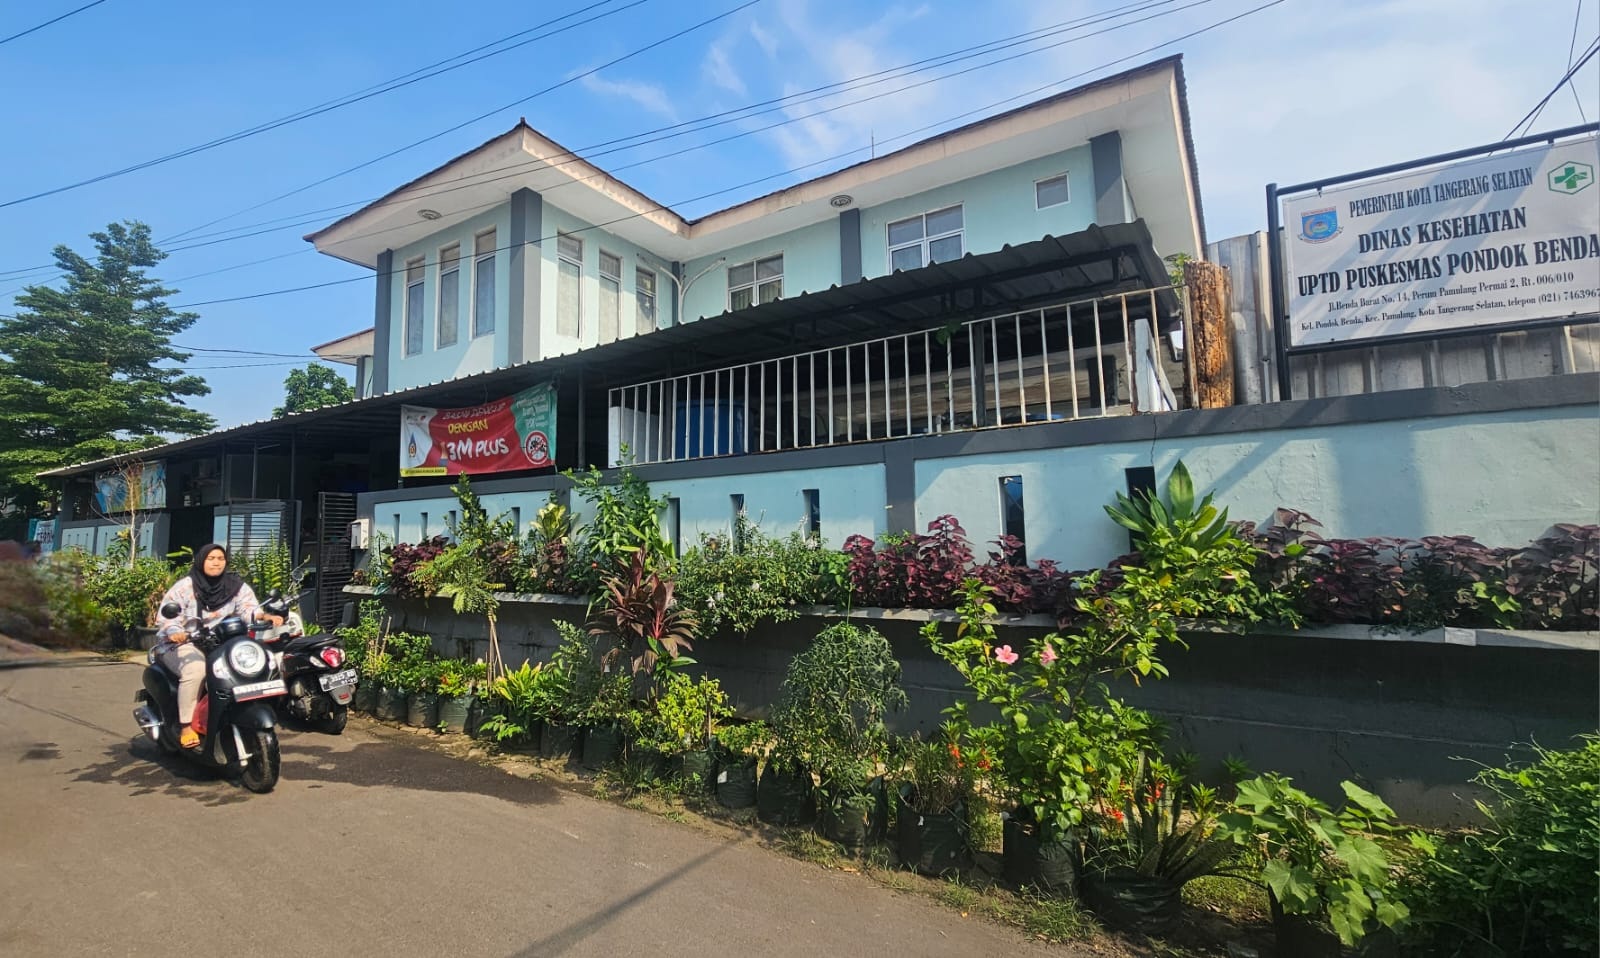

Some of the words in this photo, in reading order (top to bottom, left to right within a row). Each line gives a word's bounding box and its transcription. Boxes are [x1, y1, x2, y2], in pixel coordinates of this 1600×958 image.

[1350, 192, 1404, 218] PEMERINTAH
[1407, 186, 1432, 207] KOTA
[1433, 175, 1489, 202] TANGERANG
[1492, 167, 1533, 191] SELATAN
[1358, 226, 1411, 254] DINAS
[1417, 207, 1527, 244] KESEHATAN
[1298, 271, 1340, 297] UPTD
[1345, 256, 1442, 290] PUSKESMAS
[1447, 243, 1528, 276] PONDOK
[1534, 234, 1600, 265] BENDA
[1412, 290, 1437, 300] Perum
[1440, 284, 1477, 296] Pamulang
[1479, 280, 1508, 292] Permai
[1316, 319, 1339, 329] Pondok
[1418, 307, 1435, 317] Kota
[1438, 302, 1474, 314] Tangerang
[1508, 296, 1536, 308] telepon
[1538, 291, 1561, 304] (021)
[448, 419, 488, 434] DENGAN
[447, 437, 473, 461] 3M
[475, 437, 509, 458] PLUS
